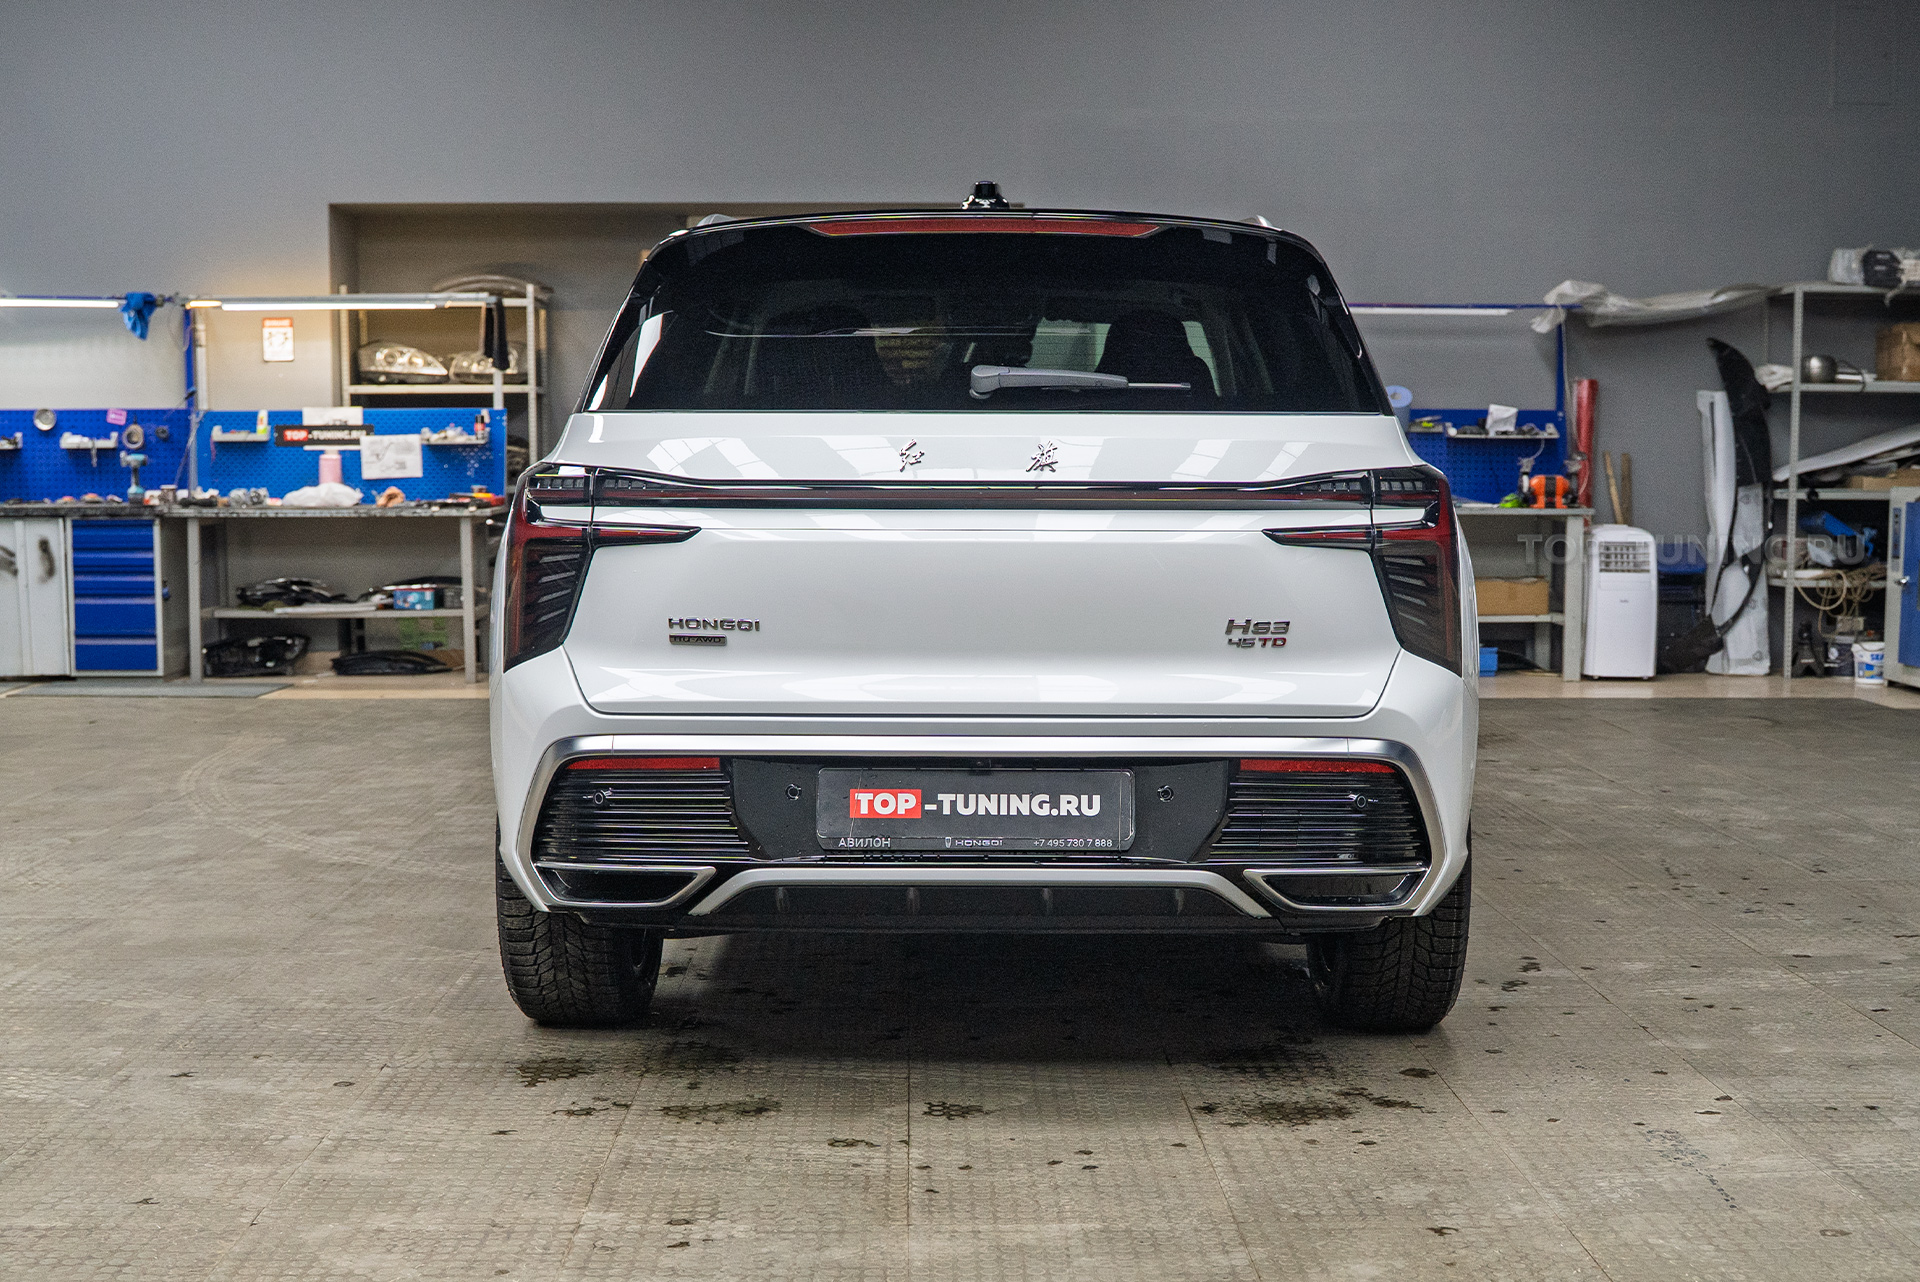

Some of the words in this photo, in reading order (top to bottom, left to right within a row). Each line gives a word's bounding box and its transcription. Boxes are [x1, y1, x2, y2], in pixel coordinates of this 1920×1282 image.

[668, 616, 760, 632] HONGQI
[838, 837, 891, 848] АВИЛОН
[1033, 839, 1045, 847] +7
[1046, 839, 1065, 848] 495
[1066, 839, 1085, 848] 730
[1086, 839, 1093, 847] 7
[1094, 839, 1113, 848] 888
